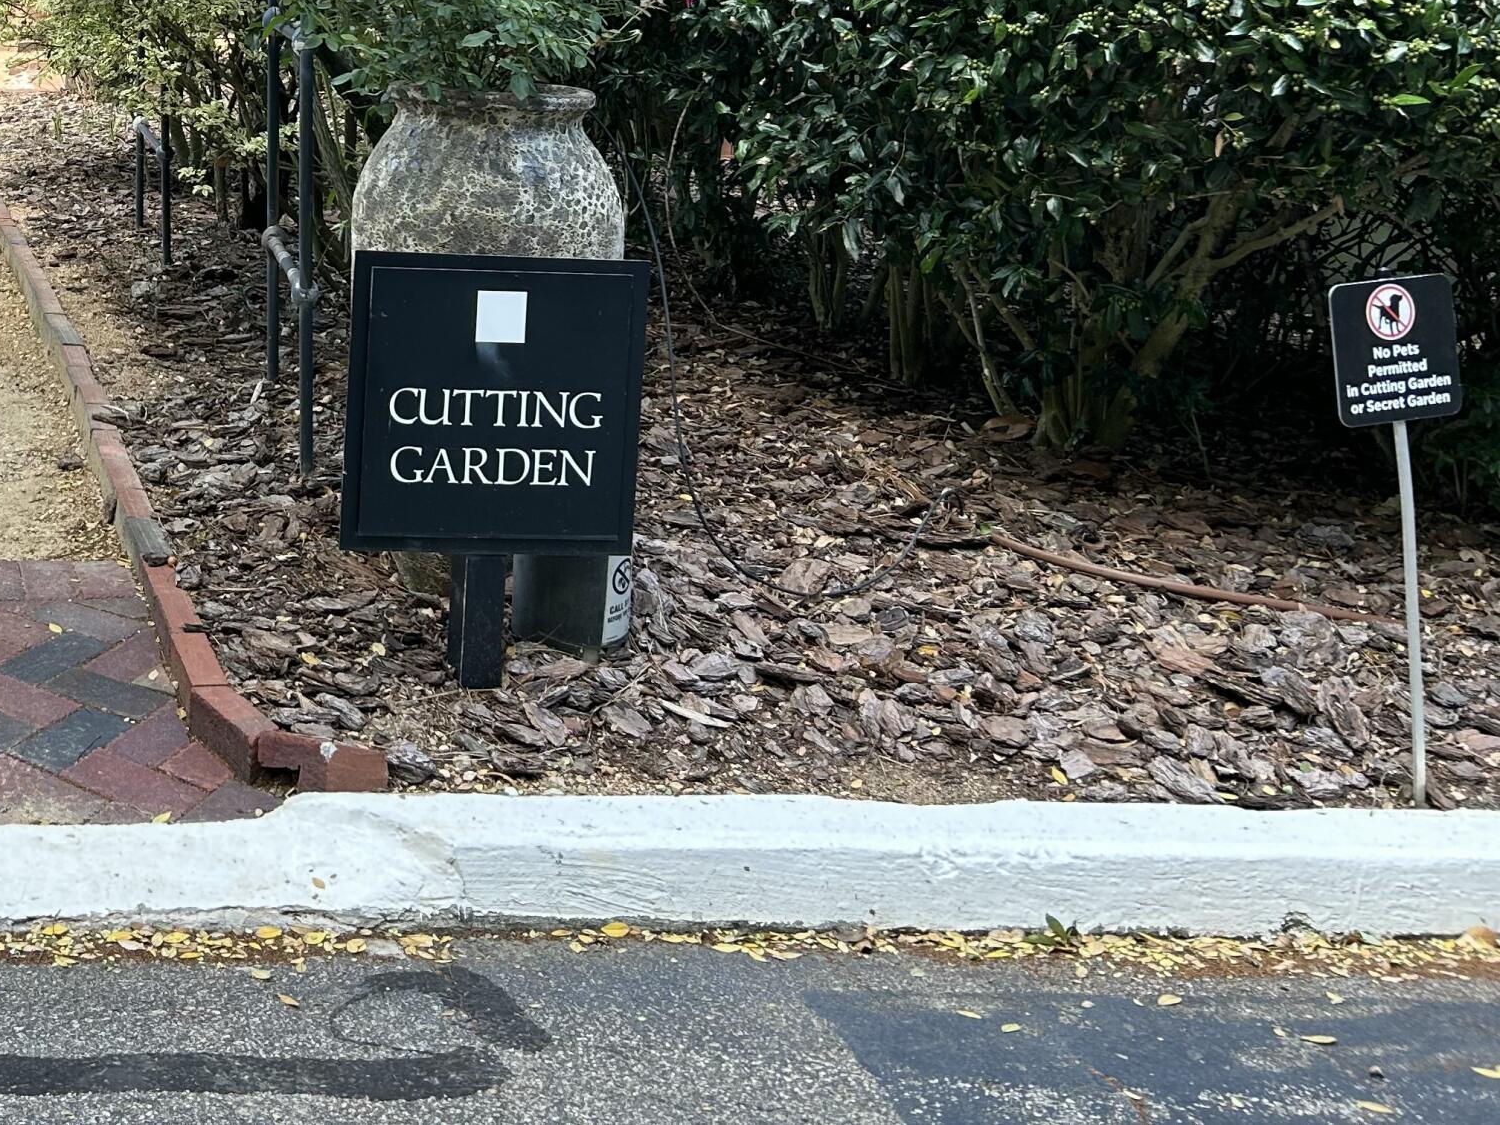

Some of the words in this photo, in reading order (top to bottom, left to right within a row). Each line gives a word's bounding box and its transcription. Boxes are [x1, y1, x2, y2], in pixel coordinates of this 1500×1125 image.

[1373, 346, 1391, 359] No
[1393, 344, 1420, 356] Pets
[1367, 358, 1428, 377] Permitted
[1346, 384, 1359, 397] in
[1360, 379, 1406, 396] Cutting
[1408, 374, 1452, 390] Garden
[389, 387, 603, 429] CUTTING
[1351, 403, 1364, 415] or
[1367, 397, 1405, 413] Secret
[1407, 392, 1451, 407] Garden
[390, 446, 596, 486] GARDEN
[609, 602, 623, 614] CALL
